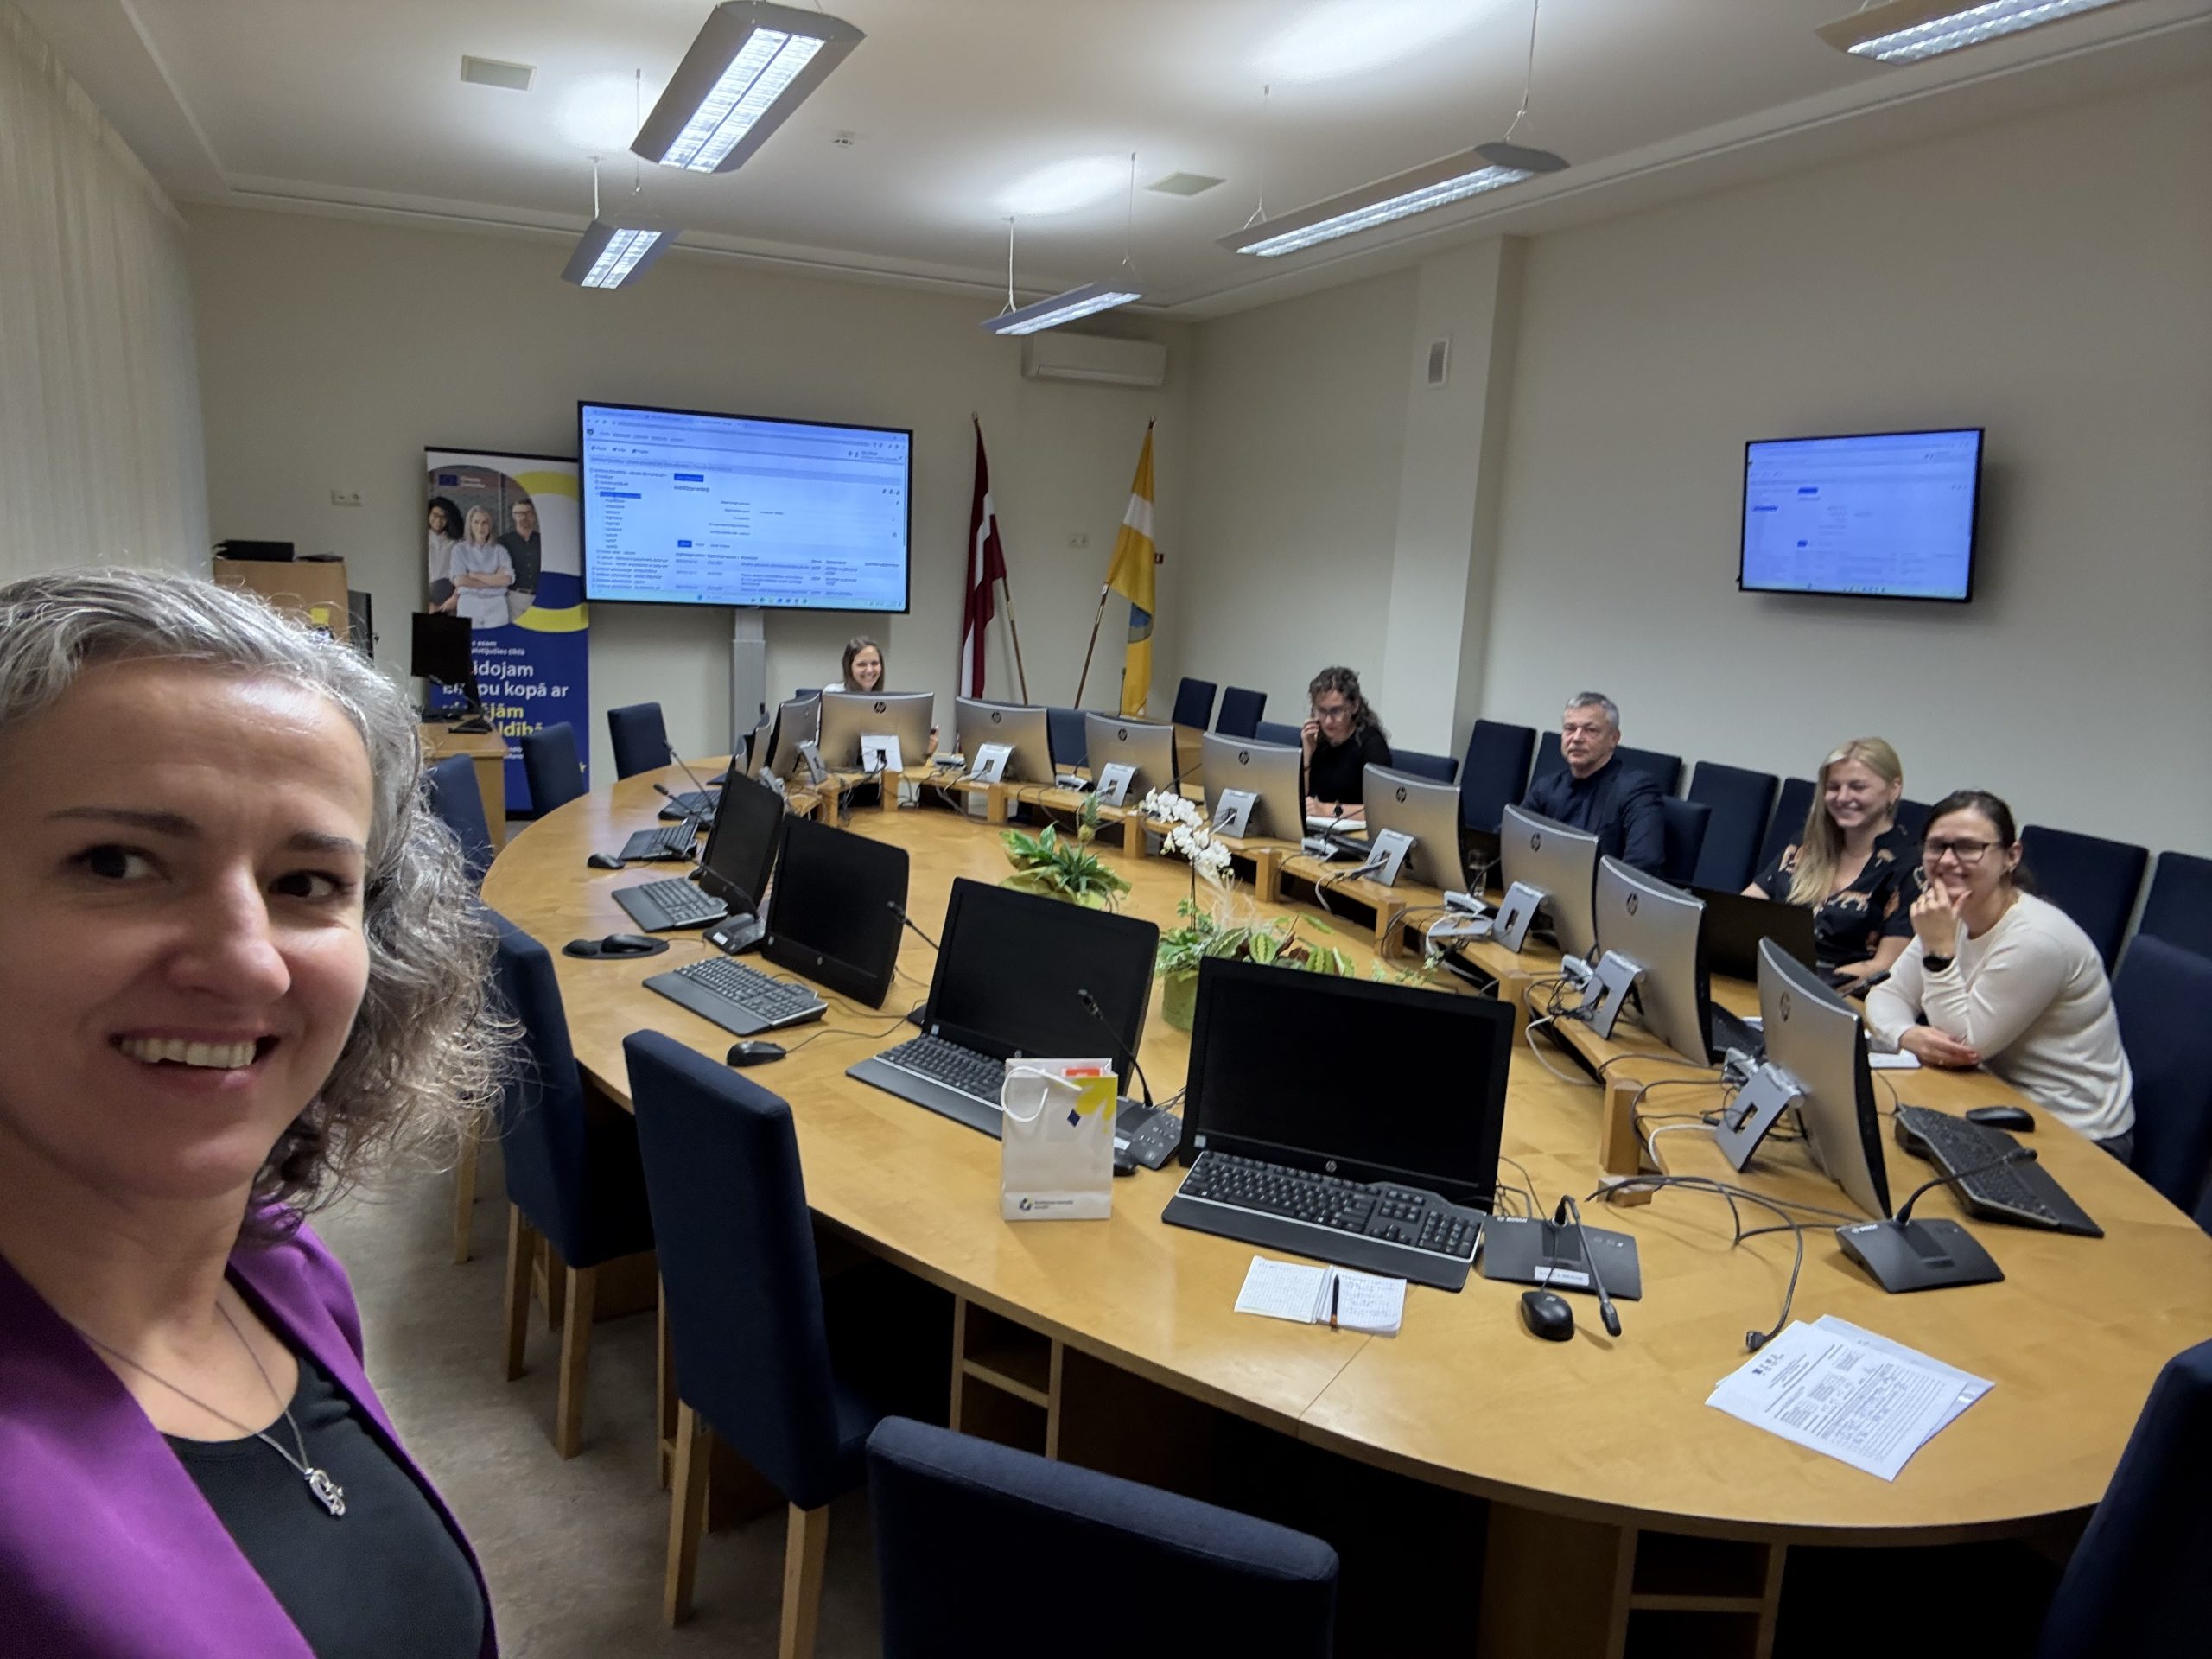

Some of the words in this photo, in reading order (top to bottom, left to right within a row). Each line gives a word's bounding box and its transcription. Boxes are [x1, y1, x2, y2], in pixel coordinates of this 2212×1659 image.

[473, 660, 534, 680] idojam
[505, 680, 547, 701] kopā
[550, 686, 569, 698] ar
